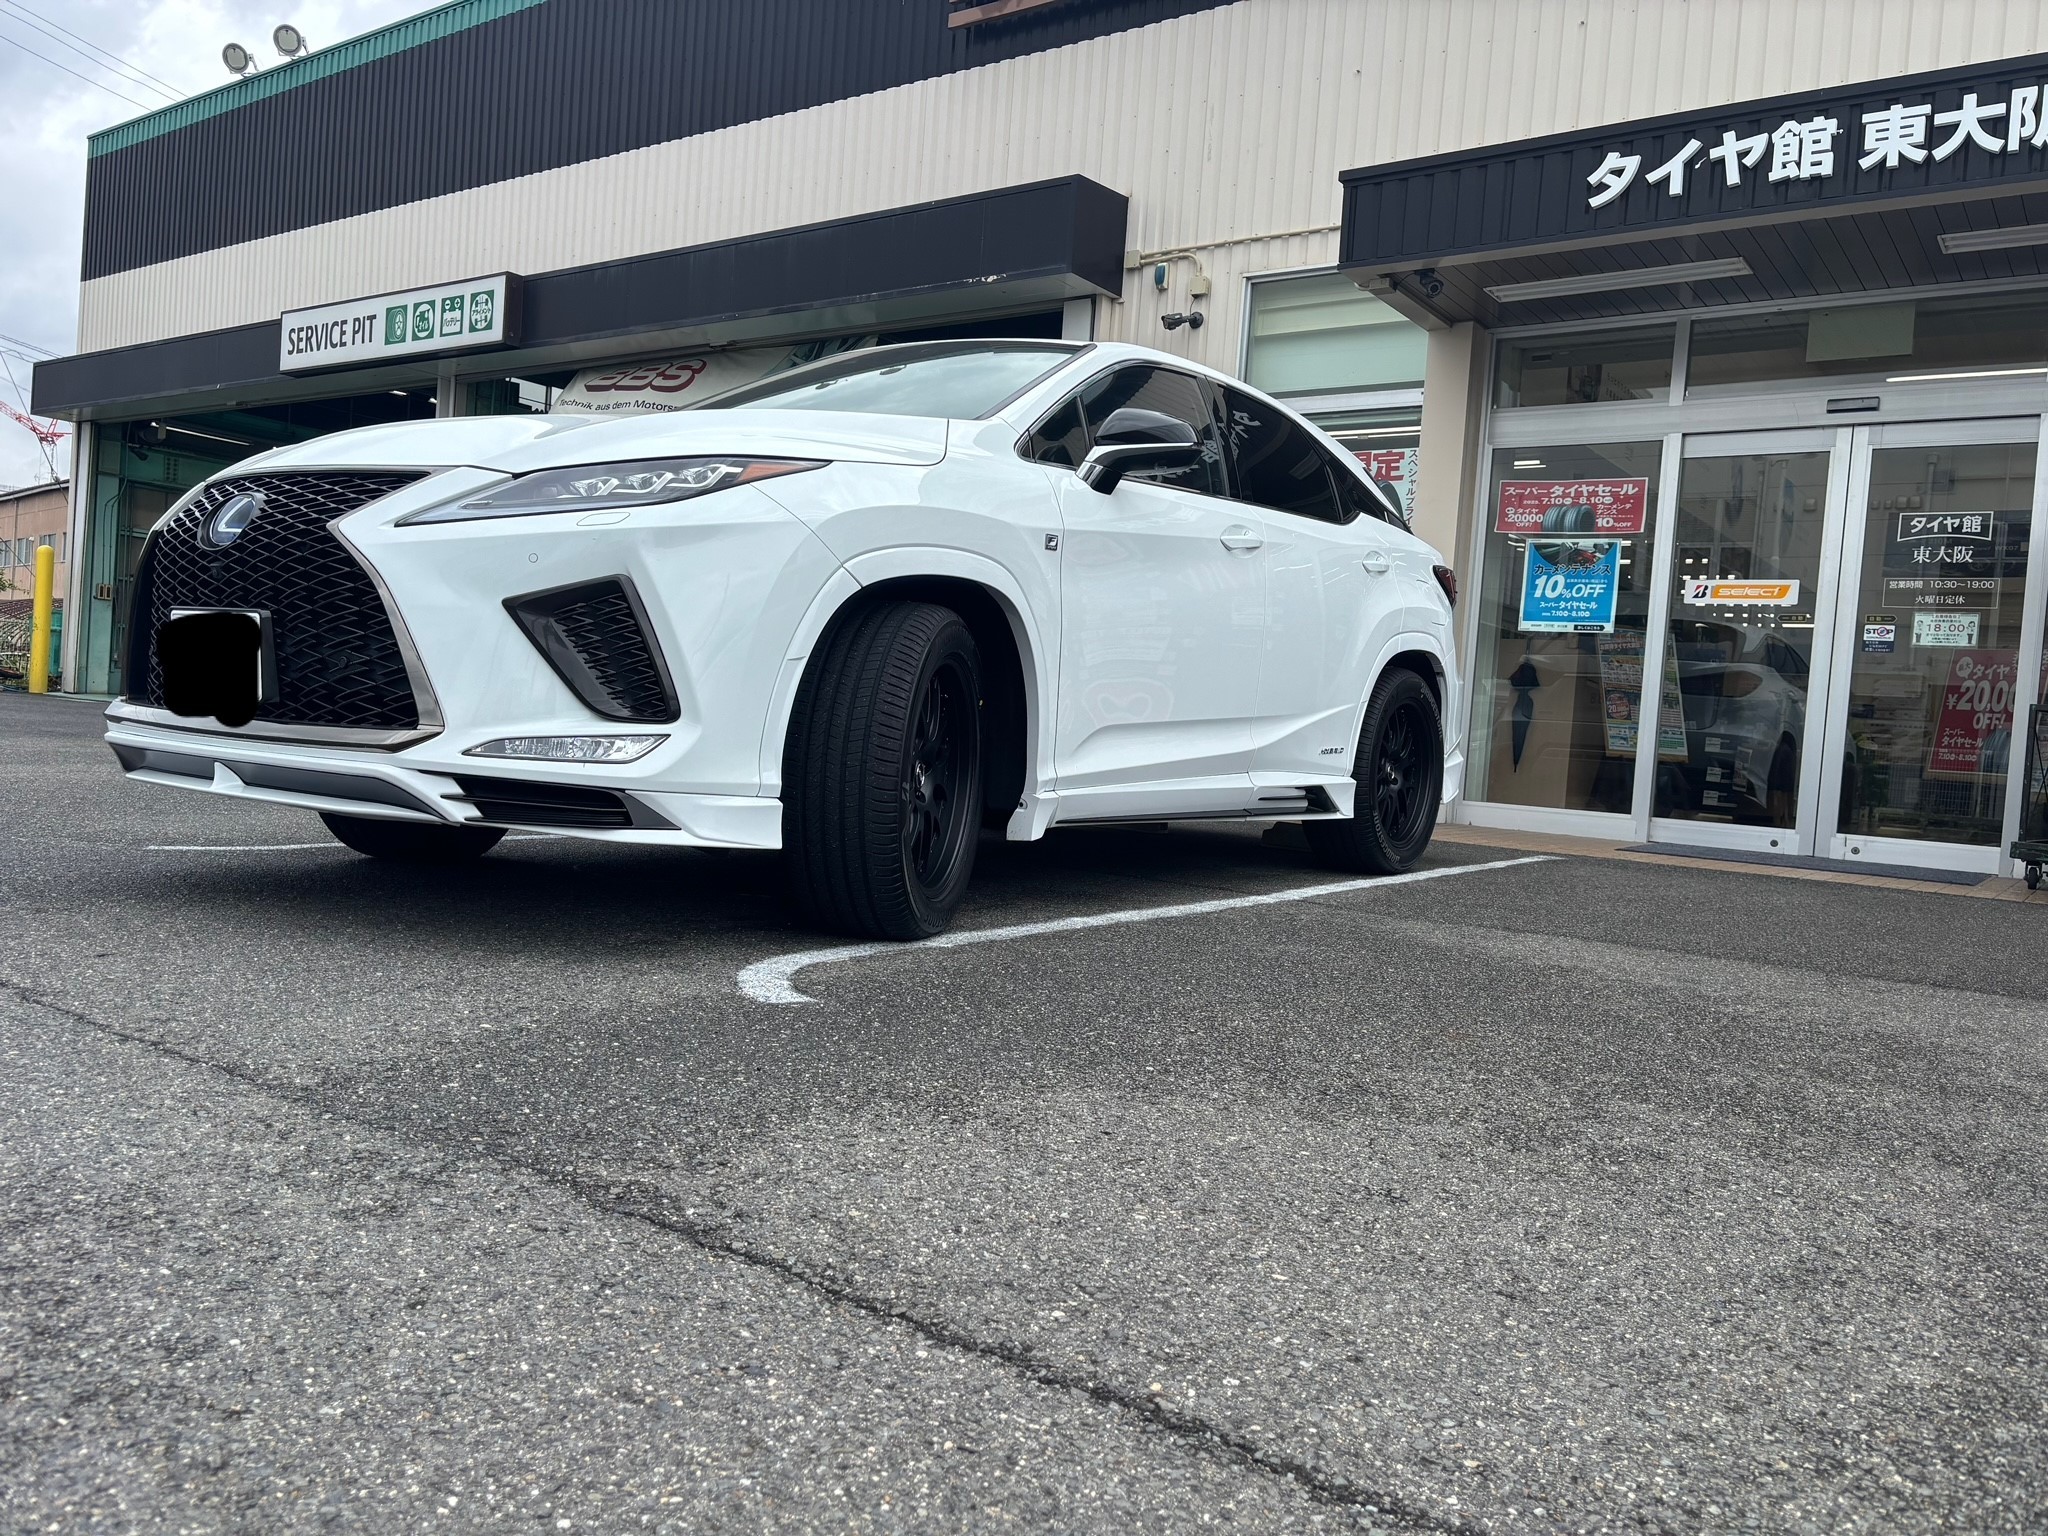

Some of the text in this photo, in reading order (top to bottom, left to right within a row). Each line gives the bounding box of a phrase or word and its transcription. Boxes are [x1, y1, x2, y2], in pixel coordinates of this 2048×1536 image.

[1586, 116, 1838, 209] タイヤ館
[288, 314, 377, 356] SERVICE PIT
[584, 358, 708, 393] BBS
[560, 399, 593, 410] Technik
[612, 401, 631, 410] dem
[1404, 449, 1418, 529] スペシャルプライ
[1910, 515, 1982, 533] タイヤ館
[1911, 545, 1975, 564] 東大阪
[1533, 563, 1612, 575] カーメンテナンス
[1889, 580, 1923, 589] 営業時間
[1540, 601, 1598, 609] スーパータイヤセール
[1915, 595, 1966, 604] 火曜日定休
[1926, 623, 1966, 633] 18:00
[1973, 664, 2010, 680] タイヤ
[1972, 713, 2006, 730] OFF!
[1942, 735, 1984, 748] タイヤセール
